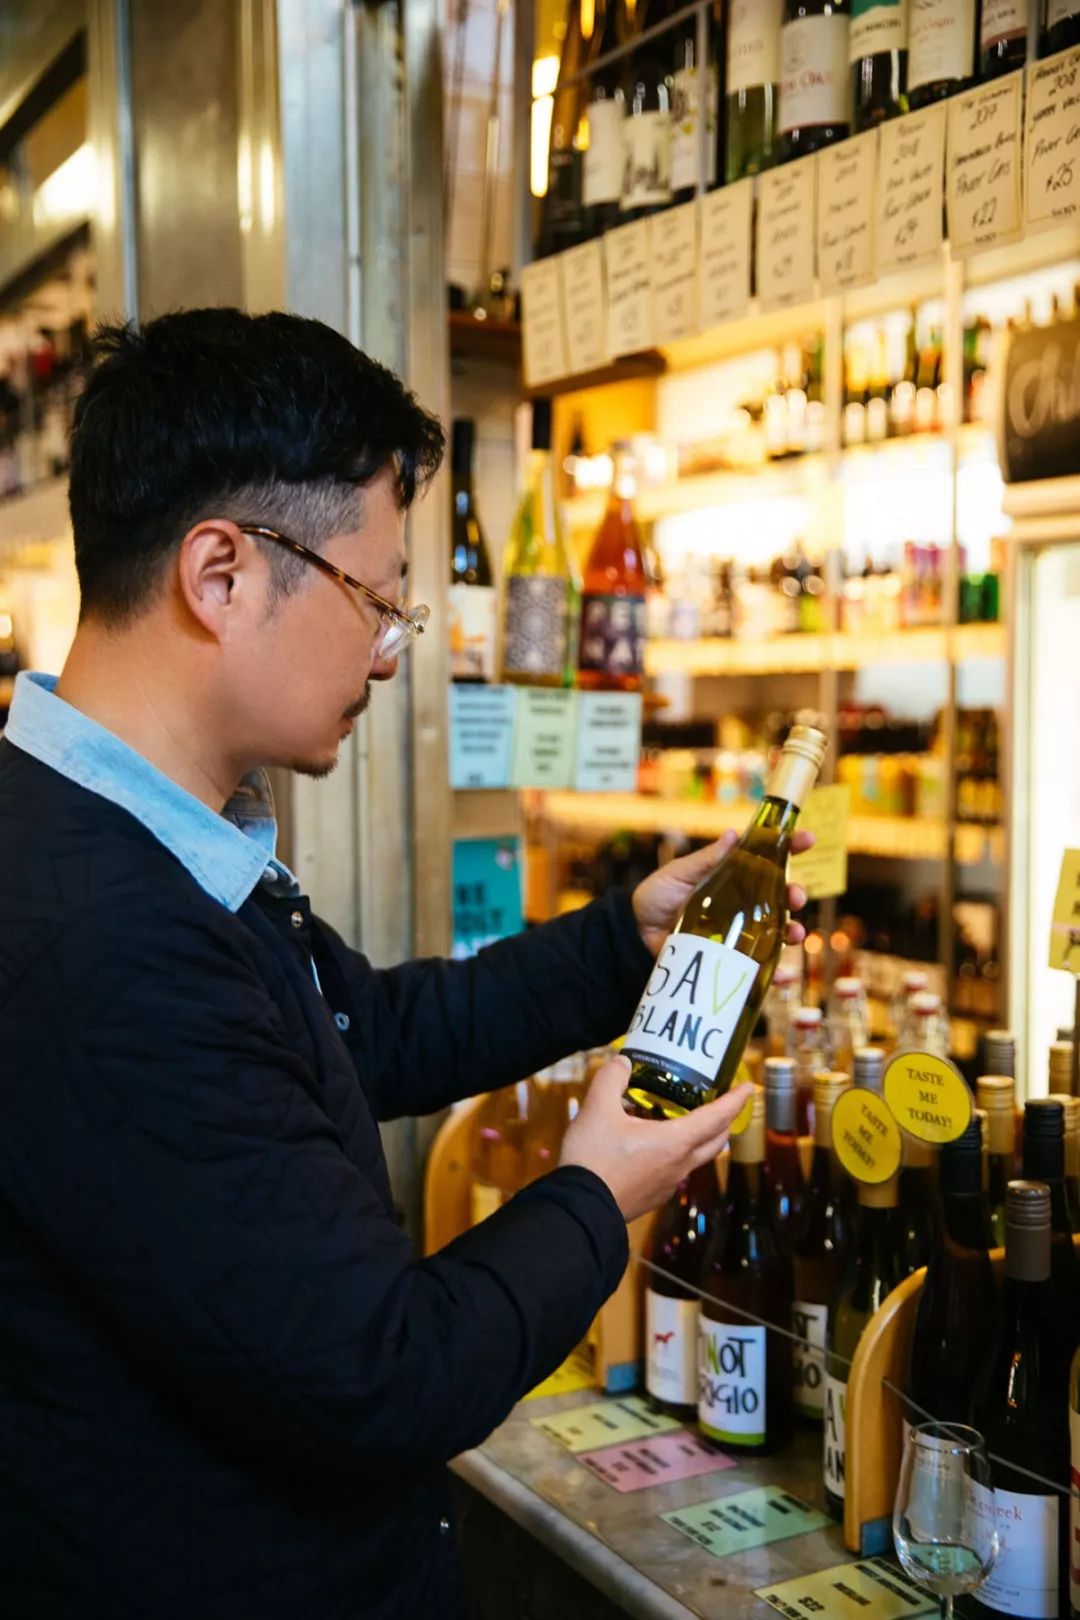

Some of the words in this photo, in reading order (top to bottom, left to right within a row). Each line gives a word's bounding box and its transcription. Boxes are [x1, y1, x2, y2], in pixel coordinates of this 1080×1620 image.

[906, 1068, 944, 1087] TASTE
[918, 1089, 938, 1105] ME
[860, 1104, 889, 1138] TASTE
[907, 1107, 952, 1128] TODAY!
[858, 1124, 874, 1144] ME
